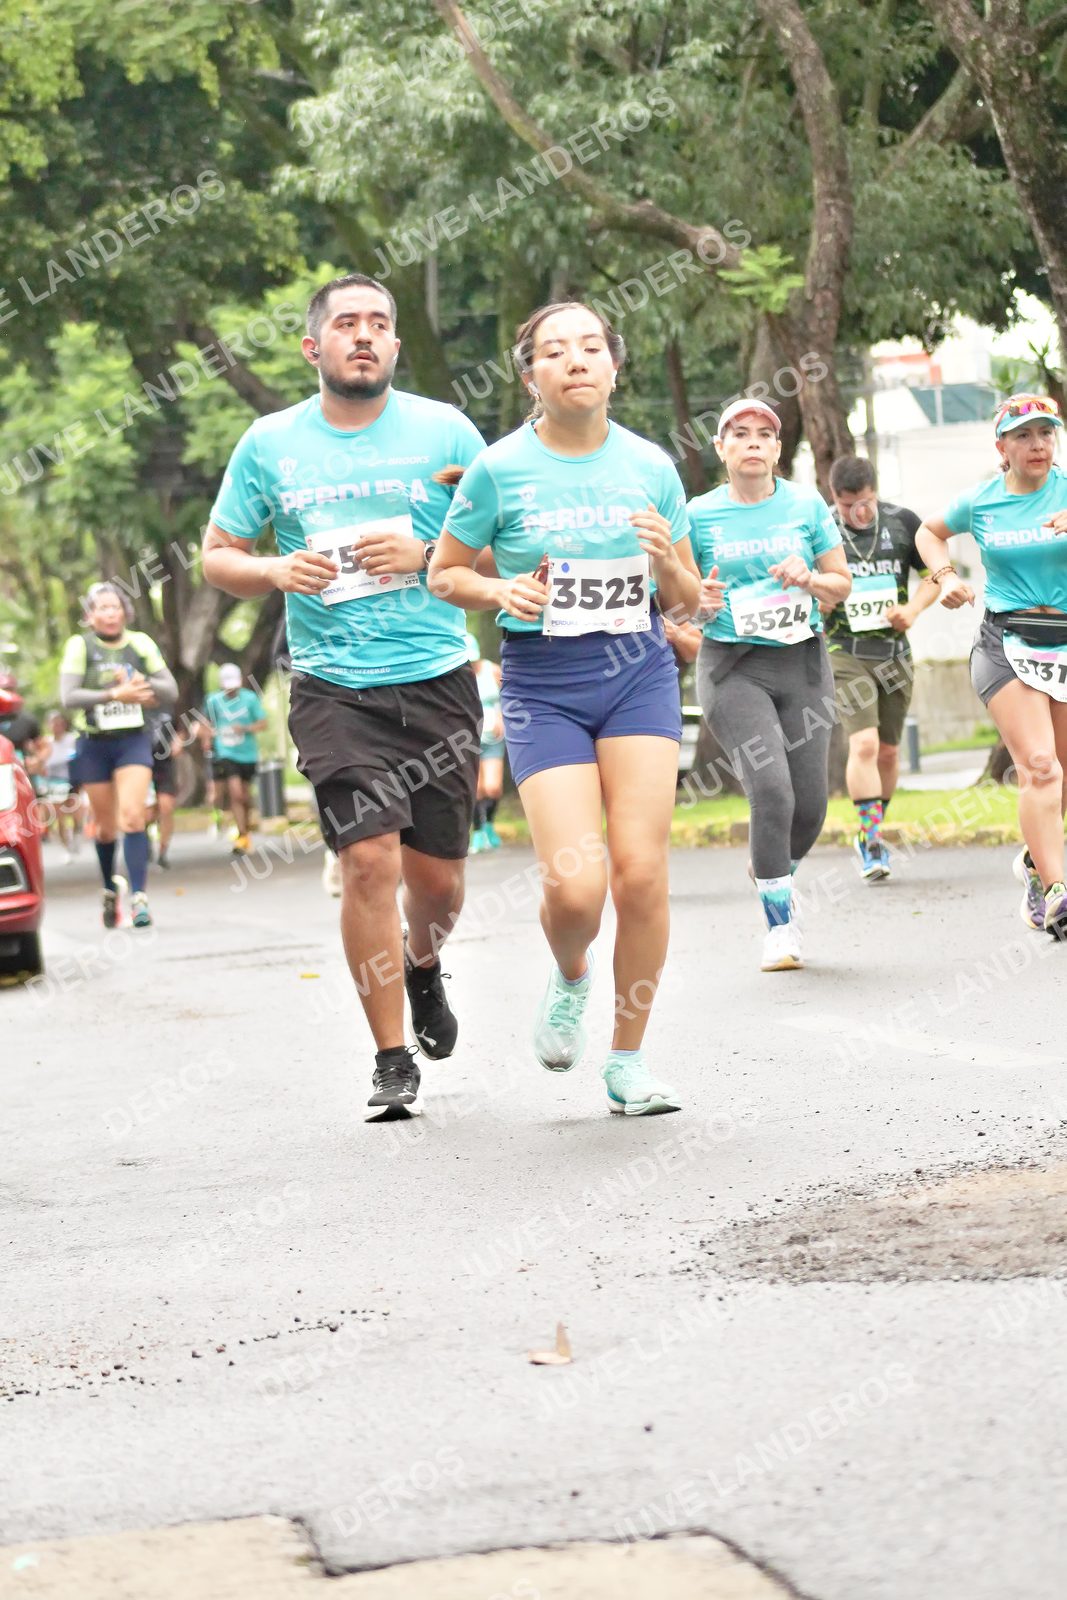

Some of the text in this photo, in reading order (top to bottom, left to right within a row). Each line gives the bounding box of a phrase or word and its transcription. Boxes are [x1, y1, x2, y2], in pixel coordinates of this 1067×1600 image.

[523, 505, 640, 536] PERDUR
[712, 534, 803, 561] PERDURA
[551, 574, 645, 611] 3523
[740, 604, 808, 635] 3524
